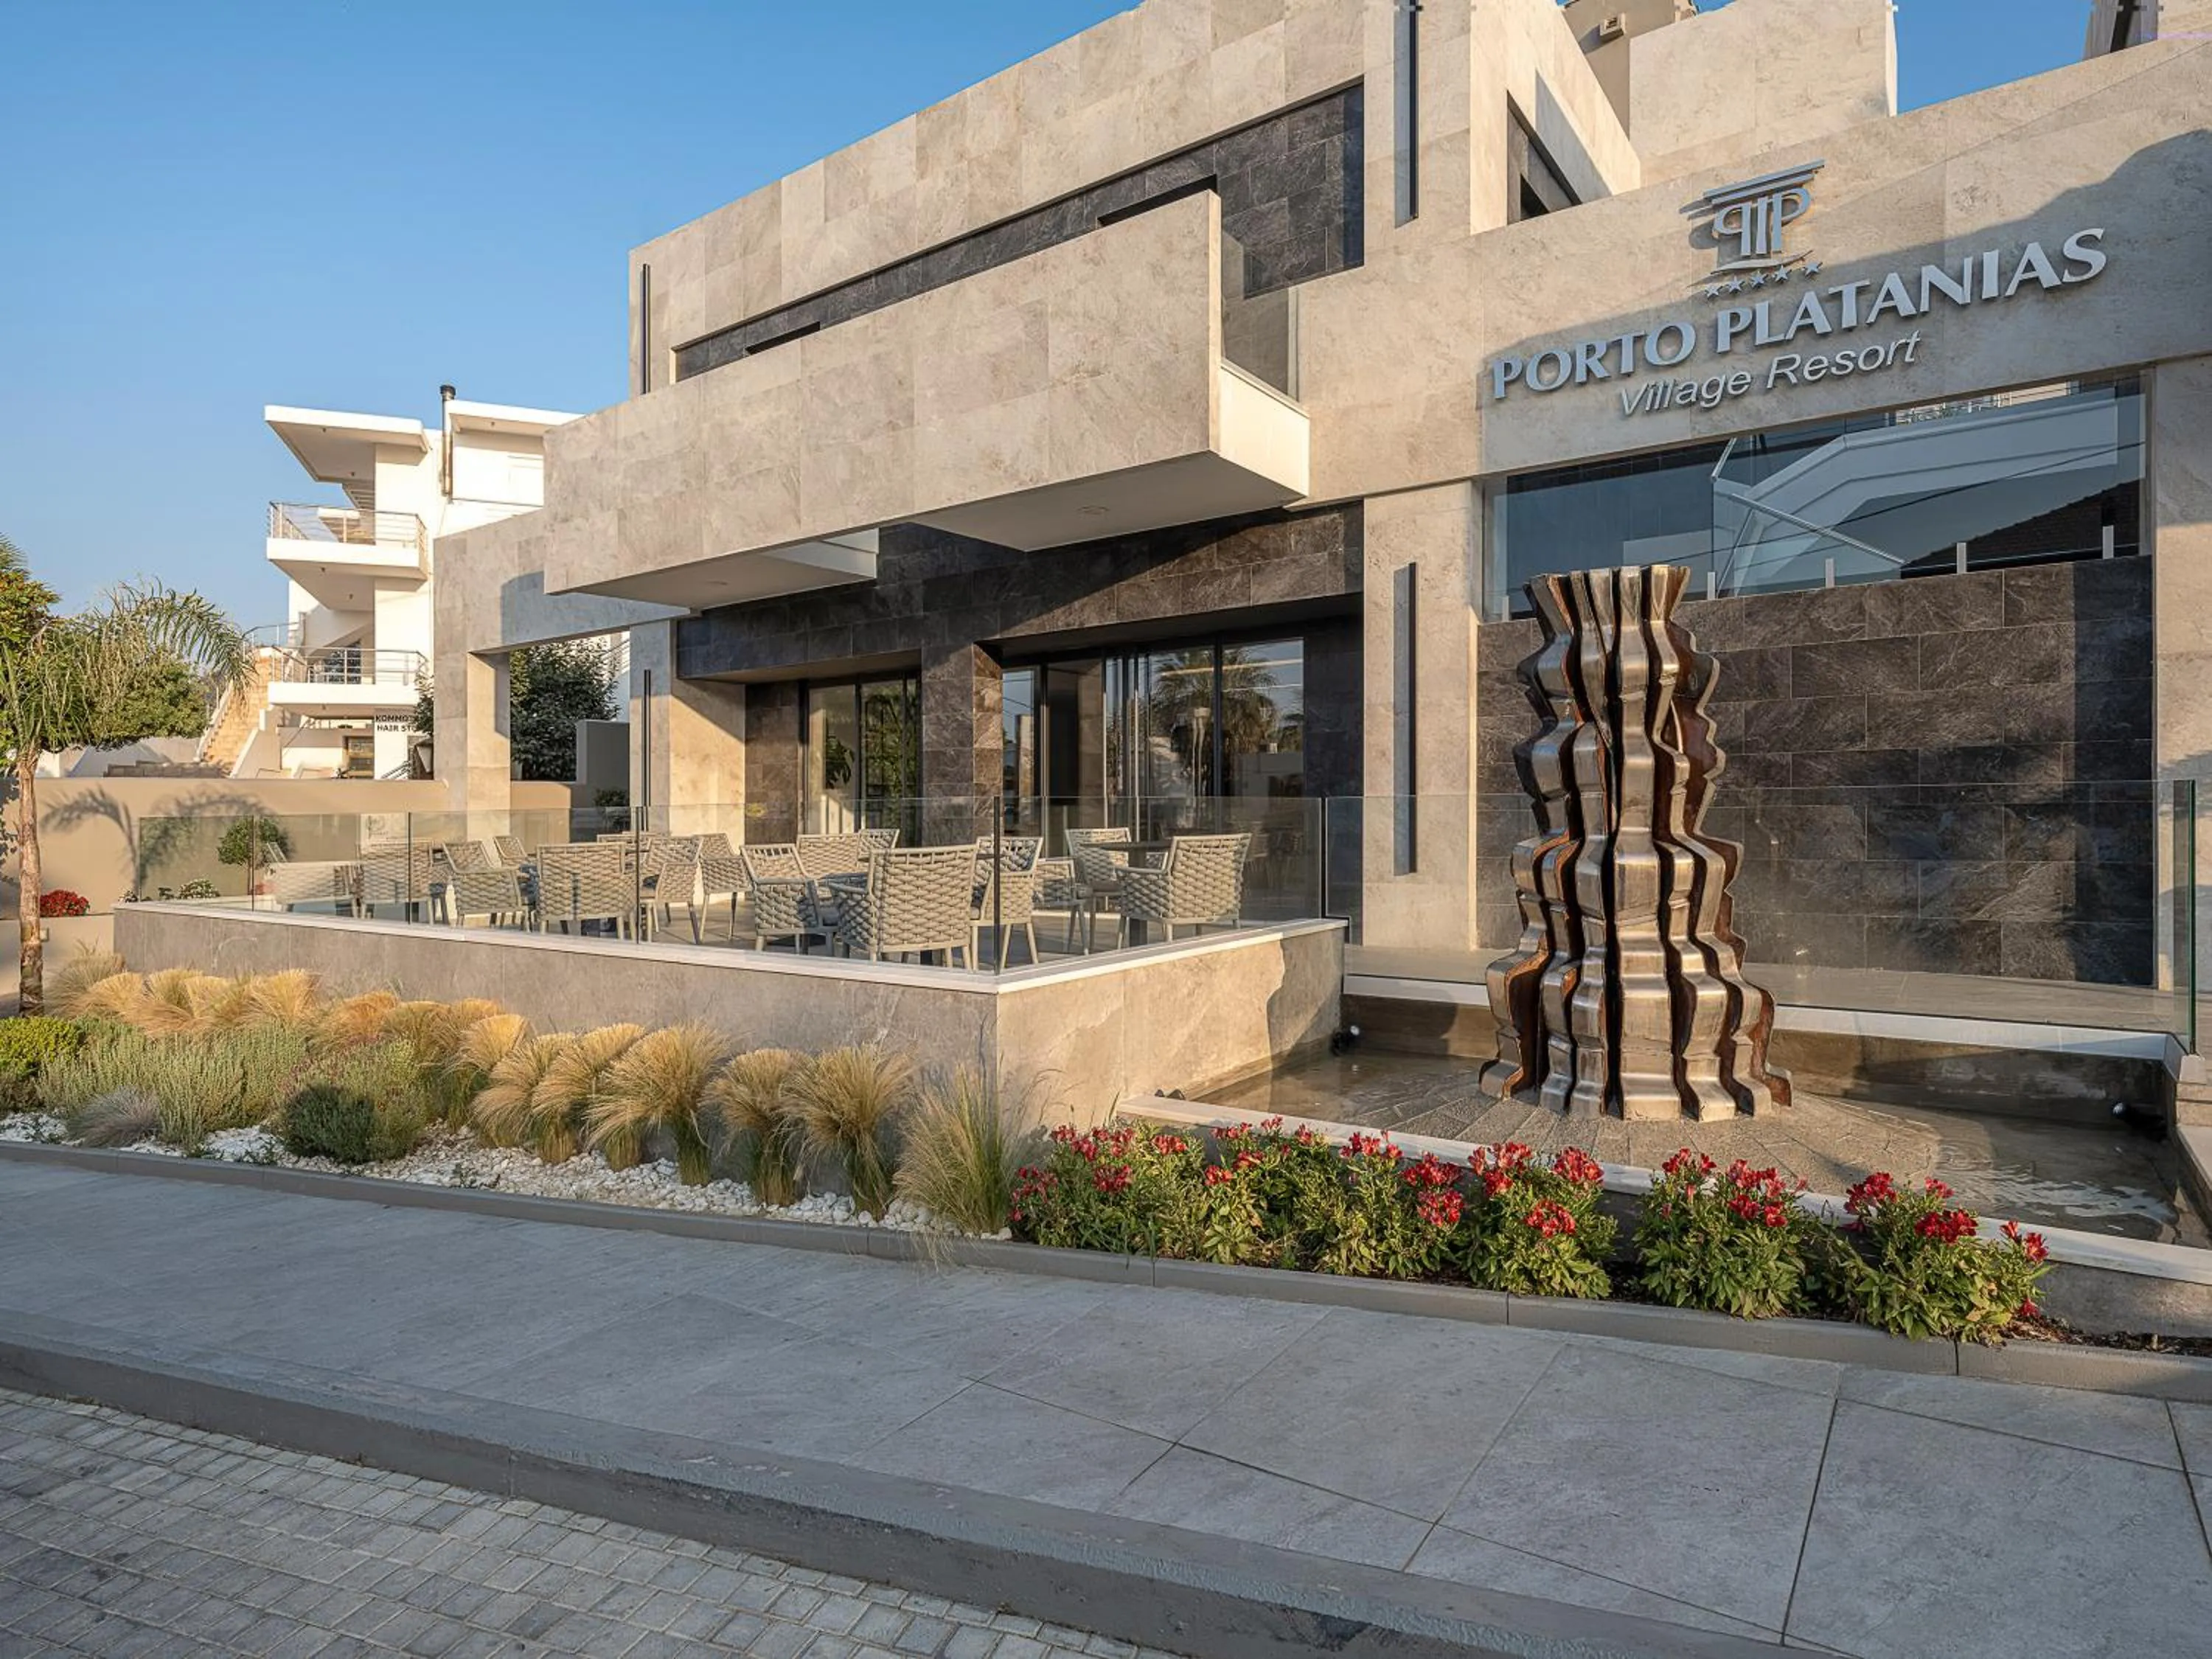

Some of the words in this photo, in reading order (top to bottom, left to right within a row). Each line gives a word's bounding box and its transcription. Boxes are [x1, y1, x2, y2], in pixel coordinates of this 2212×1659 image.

[1492, 321, 1696, 399] PORTO
[1716, 228, 2107, 353] PLATANIAS
[1621, 370, 1752, 416] Village
[1767, 330, 1920, 389] Resort
[377, 724, 399, 732] HAIR
